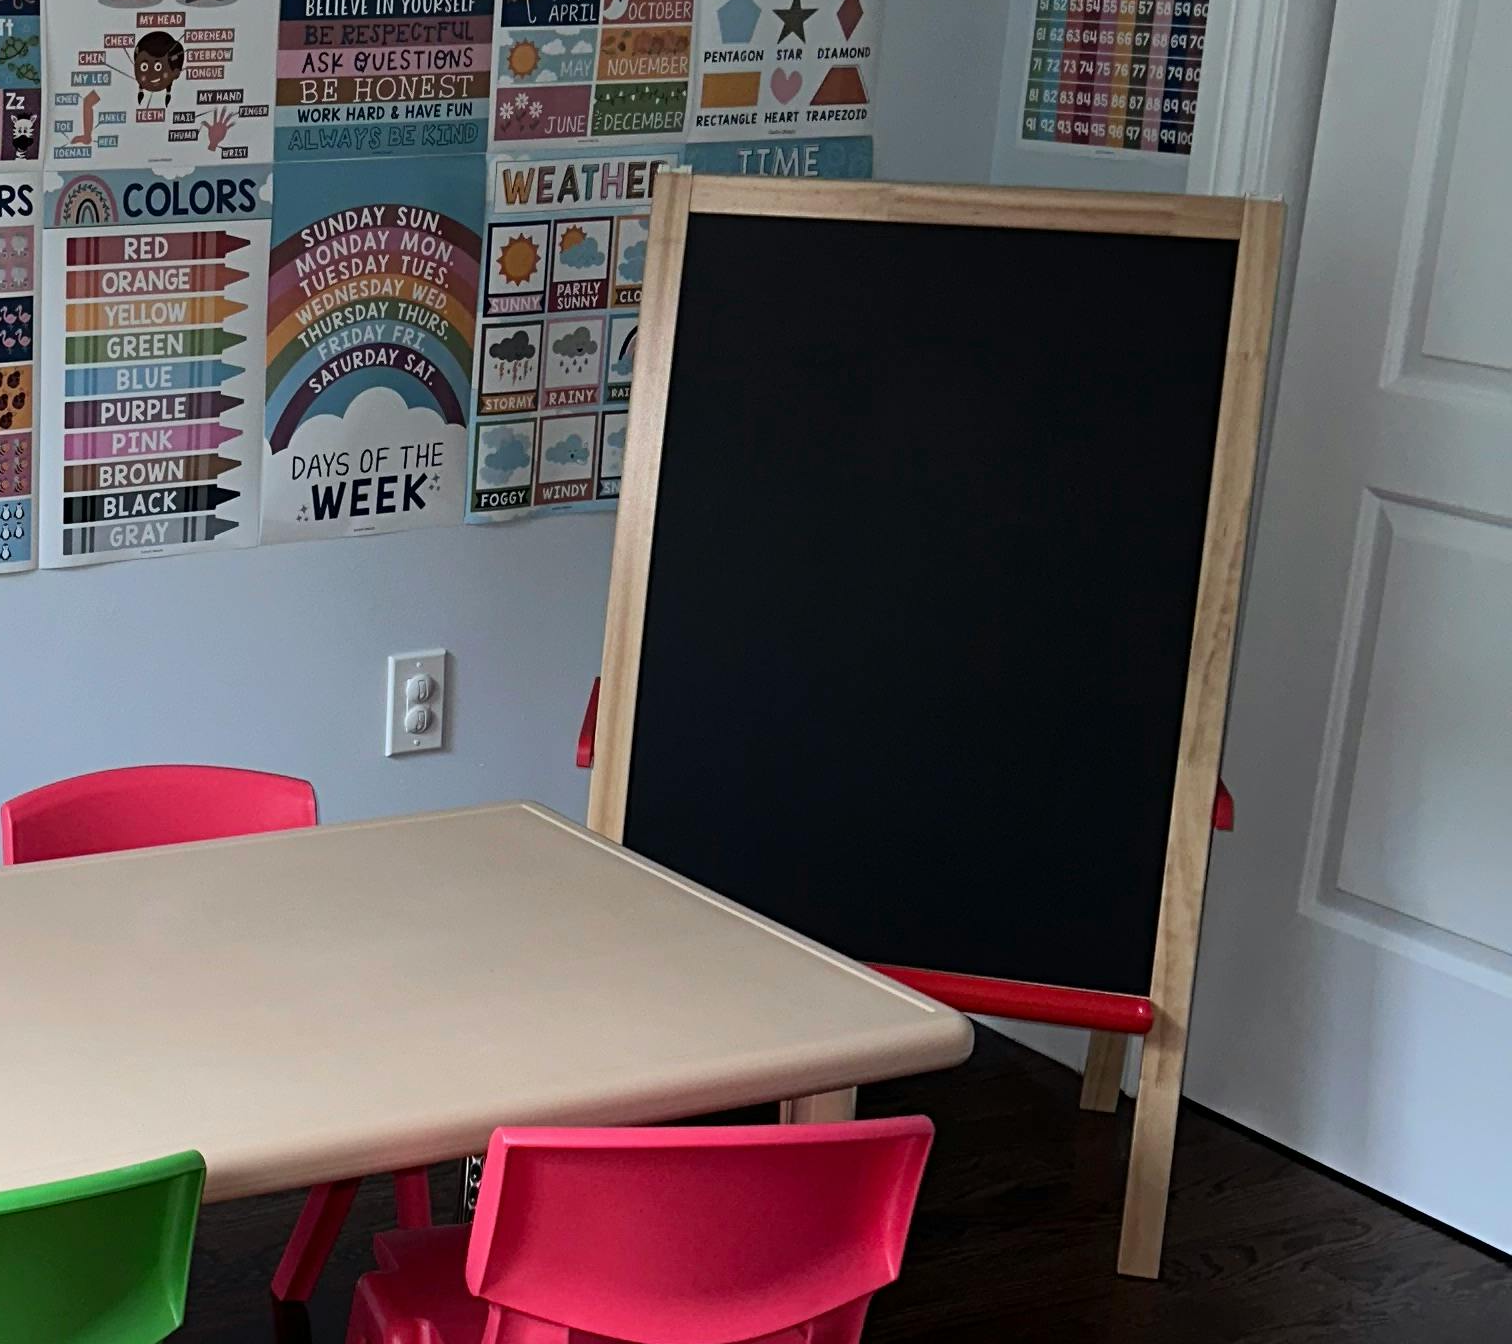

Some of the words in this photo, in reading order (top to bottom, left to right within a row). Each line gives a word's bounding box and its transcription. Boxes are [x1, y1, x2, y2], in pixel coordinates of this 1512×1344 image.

[140, 16, 153, 24] MY
[158, 14, 182, 24] HEAD
[548, 4, 597, 23] APRIL
[302, 52, 343, 73] ASK
[354, 47, 473, 72] QUESTIONS
[776, 49, 803, 60] STAR
[817, 47, 870, 59] DIAMOND
[300, 79, 338, 103] BE
[353, 75, 474, 102] HONEST
[738, 144, 820, 176] TIME
[123, 178, 257, 217] COLORS
[301, 207, 386, 248] SUNDAY
[124, 236, 168, 260] RED
[102, 268, 191, 293] ORANGE
[105, 301, 187, 327] YELLOW
[297, 302, 389, 348] THURSDAY
[107, 333, 184, 358] GREEN
[117, 367, 173, 390] BLUE
[549, 389, 595, 405] RAINY
[101, 397, 186, 424] PURPLE
[112, 430, 173, 454] PINK
[99, 459, 184, 488] BROWN
[292, 453, 350, 480] DAYS
[360, 447, 390, 472] OF
[400, 442, 444, 469] THE
[103, 491, 177, 518] BLACK
[311, 473, 428, 521] WEEK
[481, 490, 526, 507] FOGGY
[110, 522, 169, 547] GRAY
